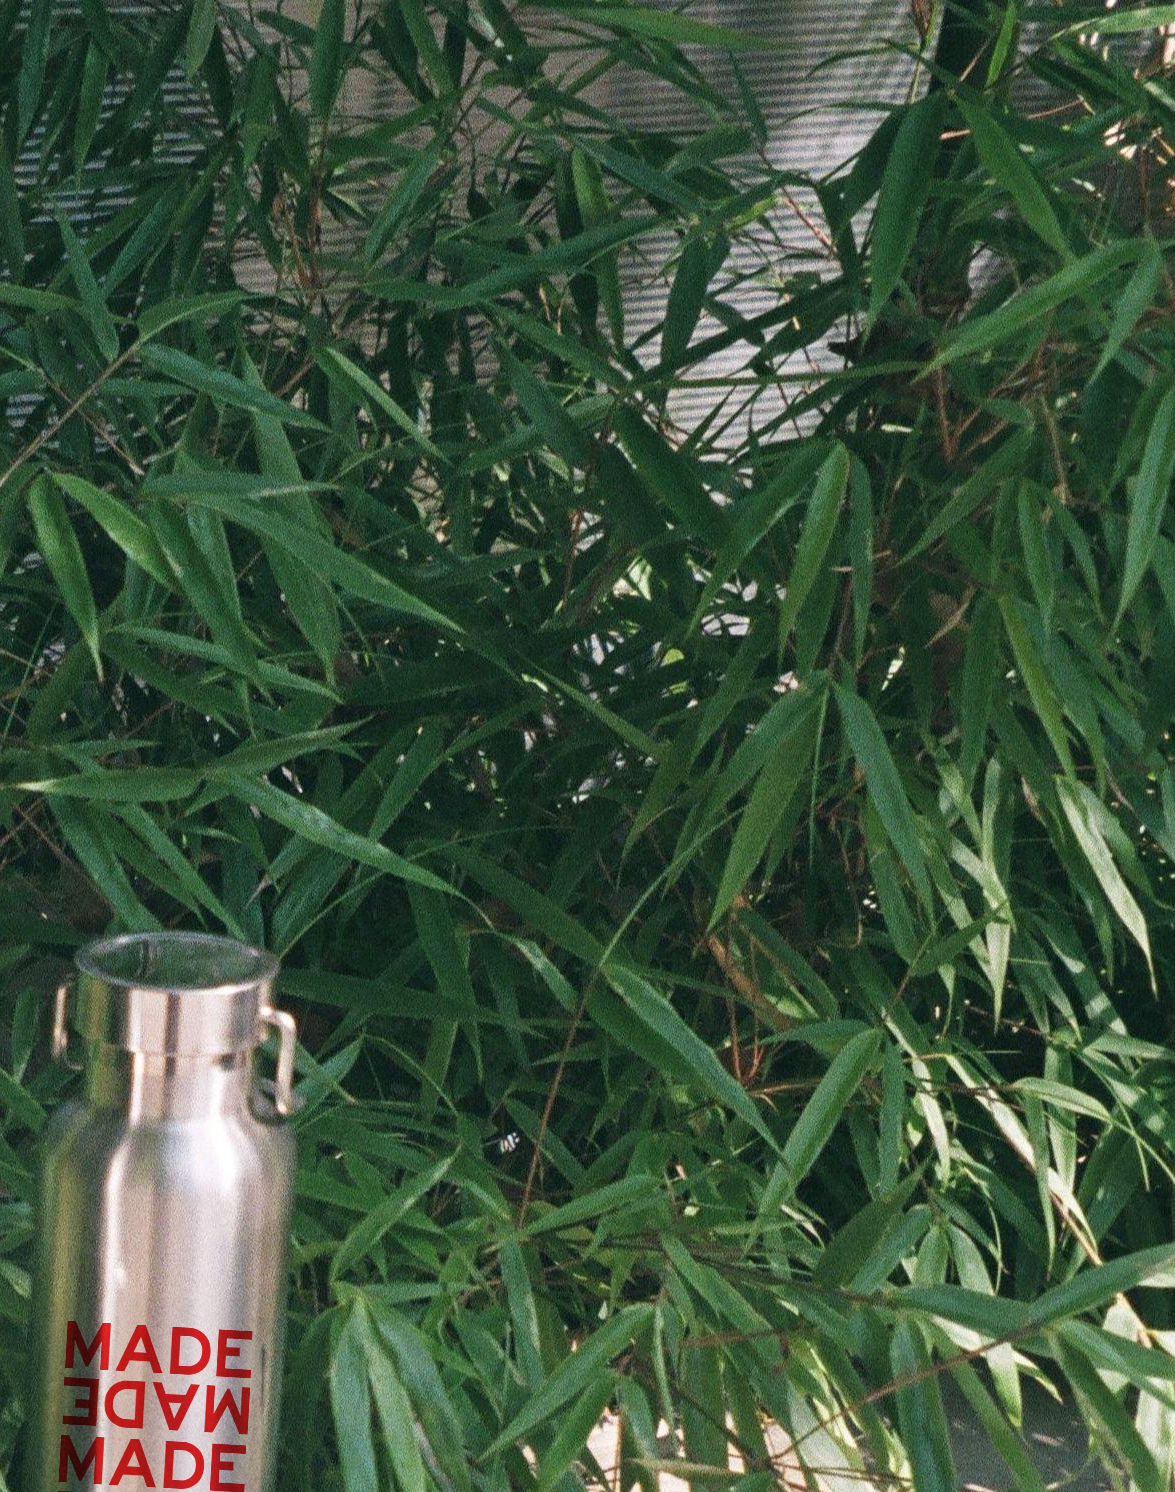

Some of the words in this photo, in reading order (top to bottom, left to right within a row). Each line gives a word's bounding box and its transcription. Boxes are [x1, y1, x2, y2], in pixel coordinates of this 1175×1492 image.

[65, 1320, 253, 1379] MADE
[62, 1376, 251, 1435] MADE
[58, 1434, 247, 1492] MADE
